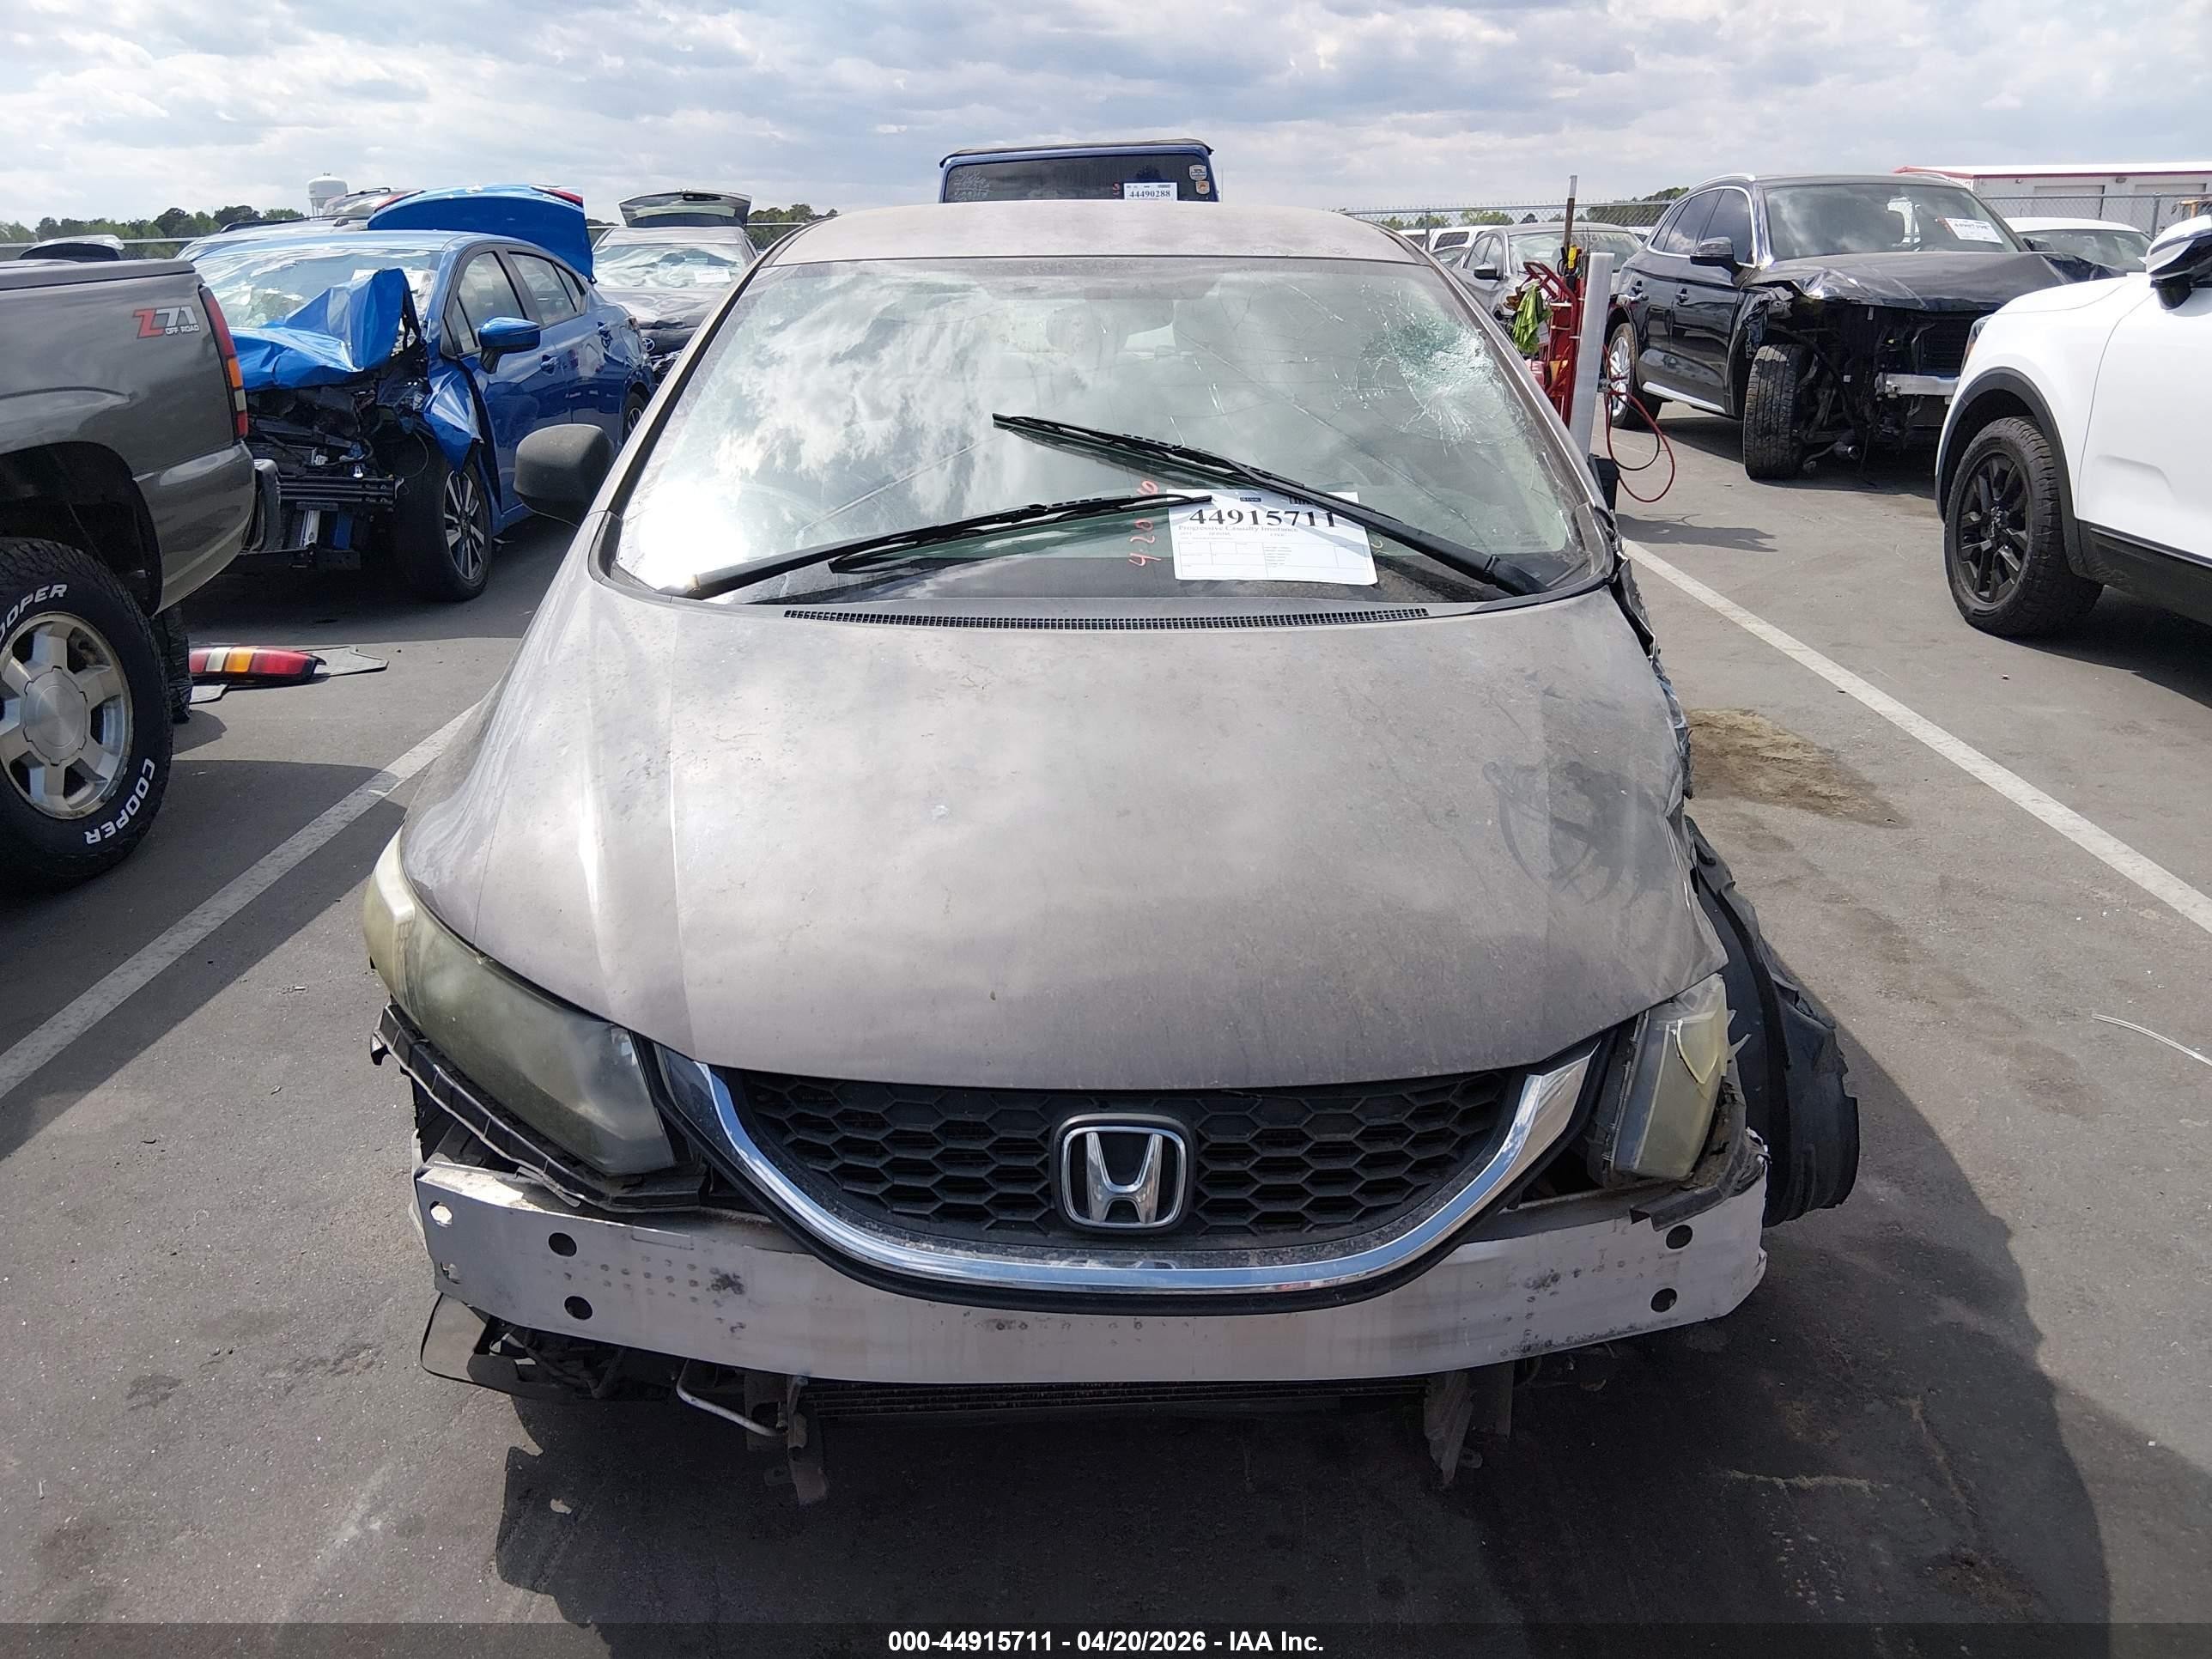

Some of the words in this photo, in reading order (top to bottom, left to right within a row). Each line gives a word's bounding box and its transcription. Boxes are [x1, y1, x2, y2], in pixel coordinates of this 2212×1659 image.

[1129, 190, 1171, 198] 44490288
[133, 306, 198, 338] Z71
[165, 327, 179, 336] OFF
[180, 325, 200, 334] ROAD
[1189, 508, 1340, 528] 44915711
[84, 757, 155, 844] COOPER
